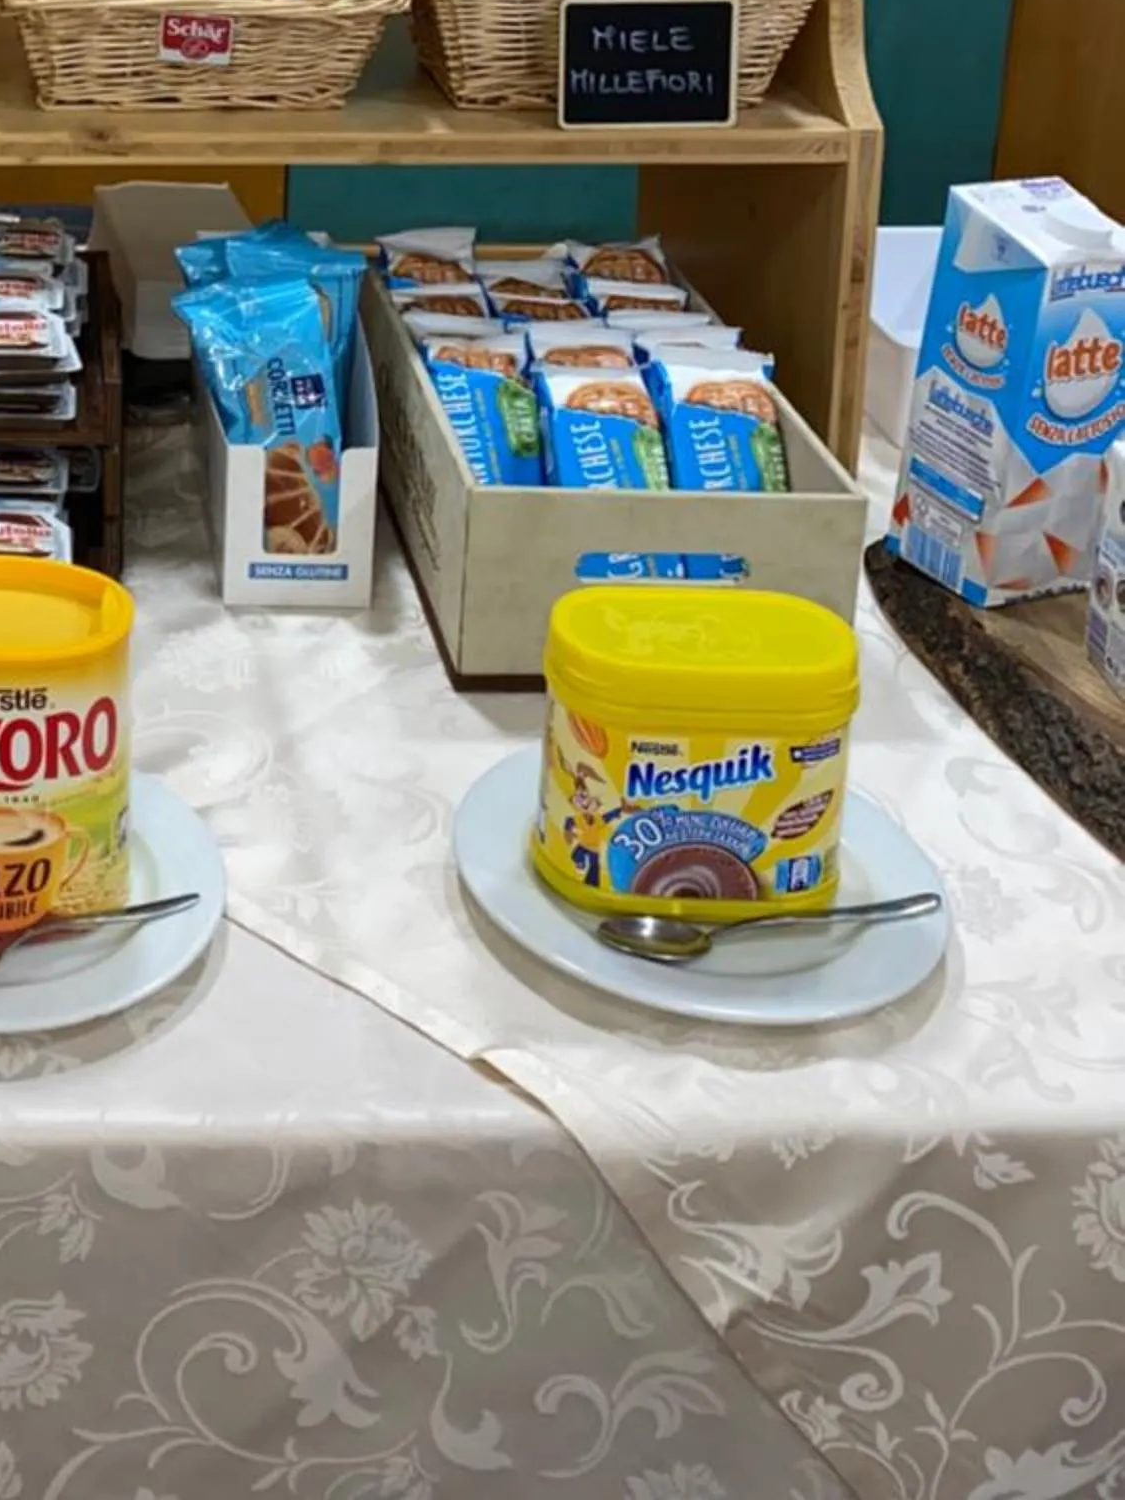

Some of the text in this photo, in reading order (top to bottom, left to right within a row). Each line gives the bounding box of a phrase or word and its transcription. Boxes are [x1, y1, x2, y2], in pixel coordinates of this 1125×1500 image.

[166, 17, 228, 43] Schär
[591, 25, 696, 52] MIELE
[570, 69, 715, 96] MILLEFIORI
[959, 305, 1005, 348] latte
[1047, 338, 1121, 380] latte
[255, 565, 292, 577] SENZA
[627, 744, 772, 801] Nesquik
